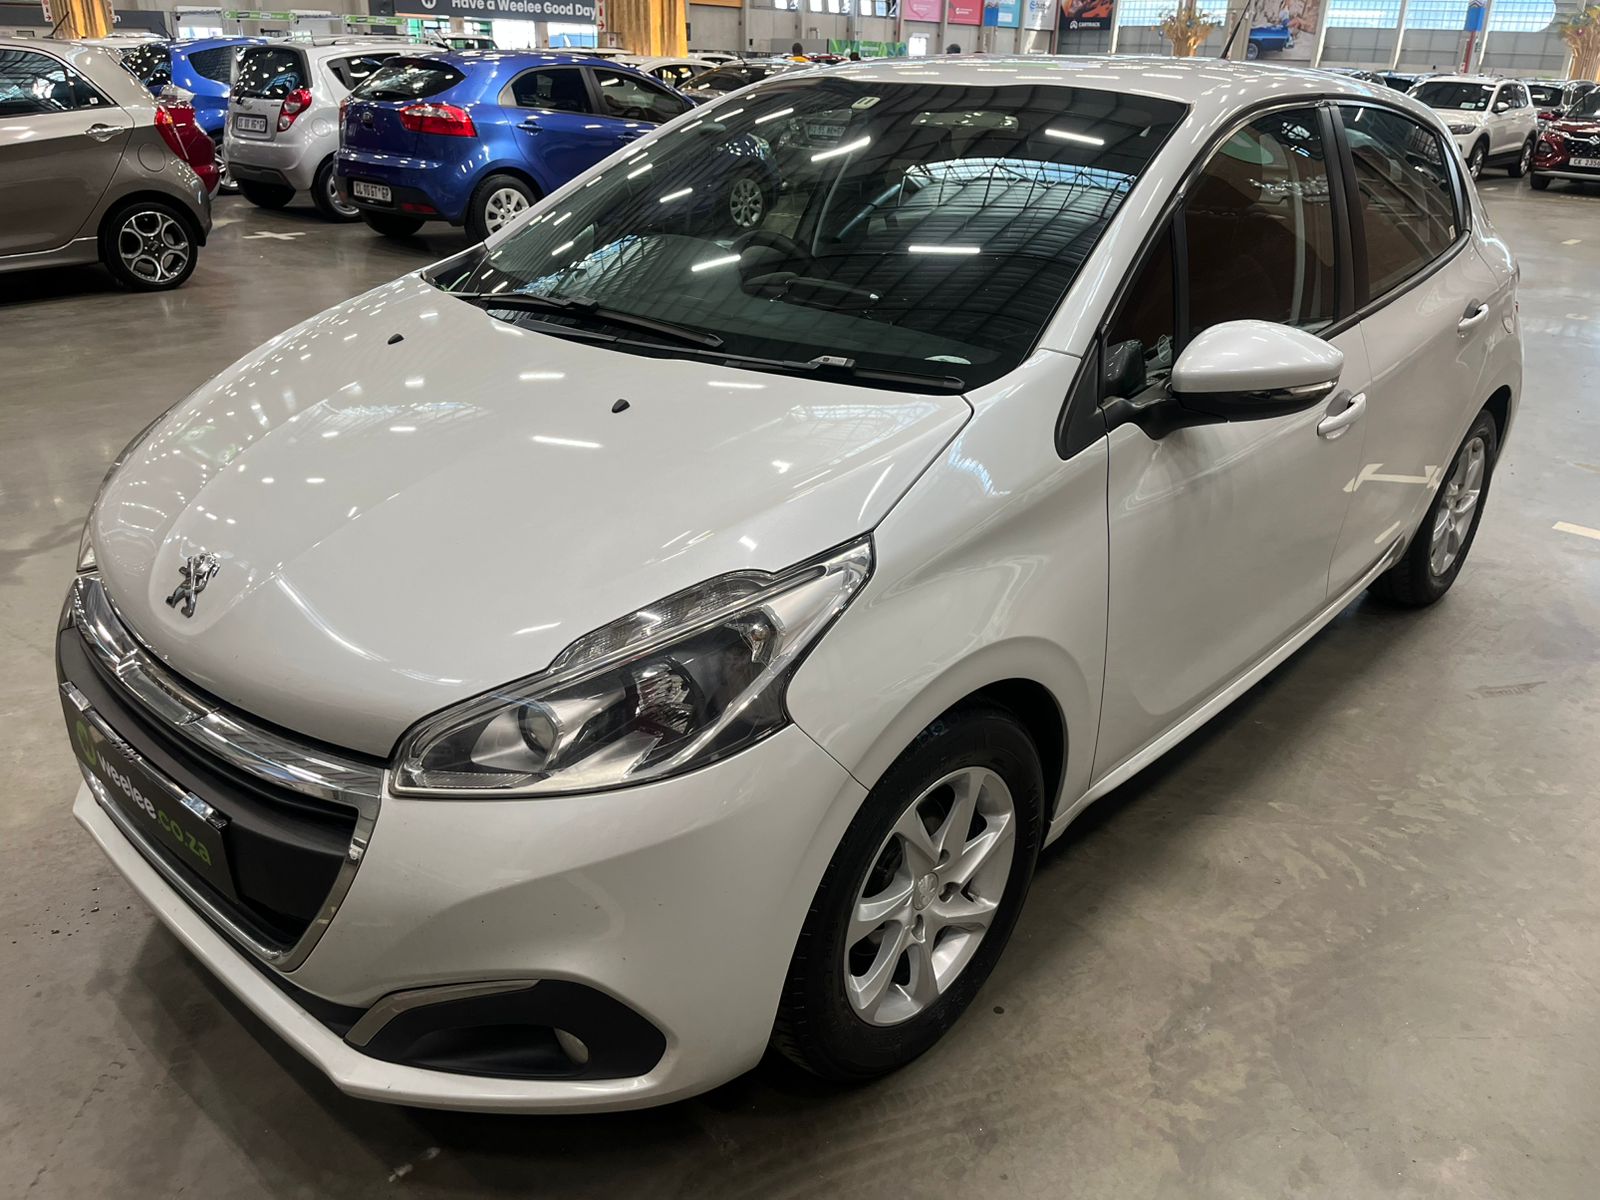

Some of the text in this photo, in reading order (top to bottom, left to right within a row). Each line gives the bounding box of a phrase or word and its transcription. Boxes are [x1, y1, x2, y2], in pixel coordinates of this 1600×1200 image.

[452, 0, 596, 20] Have a Weelee Good Day
